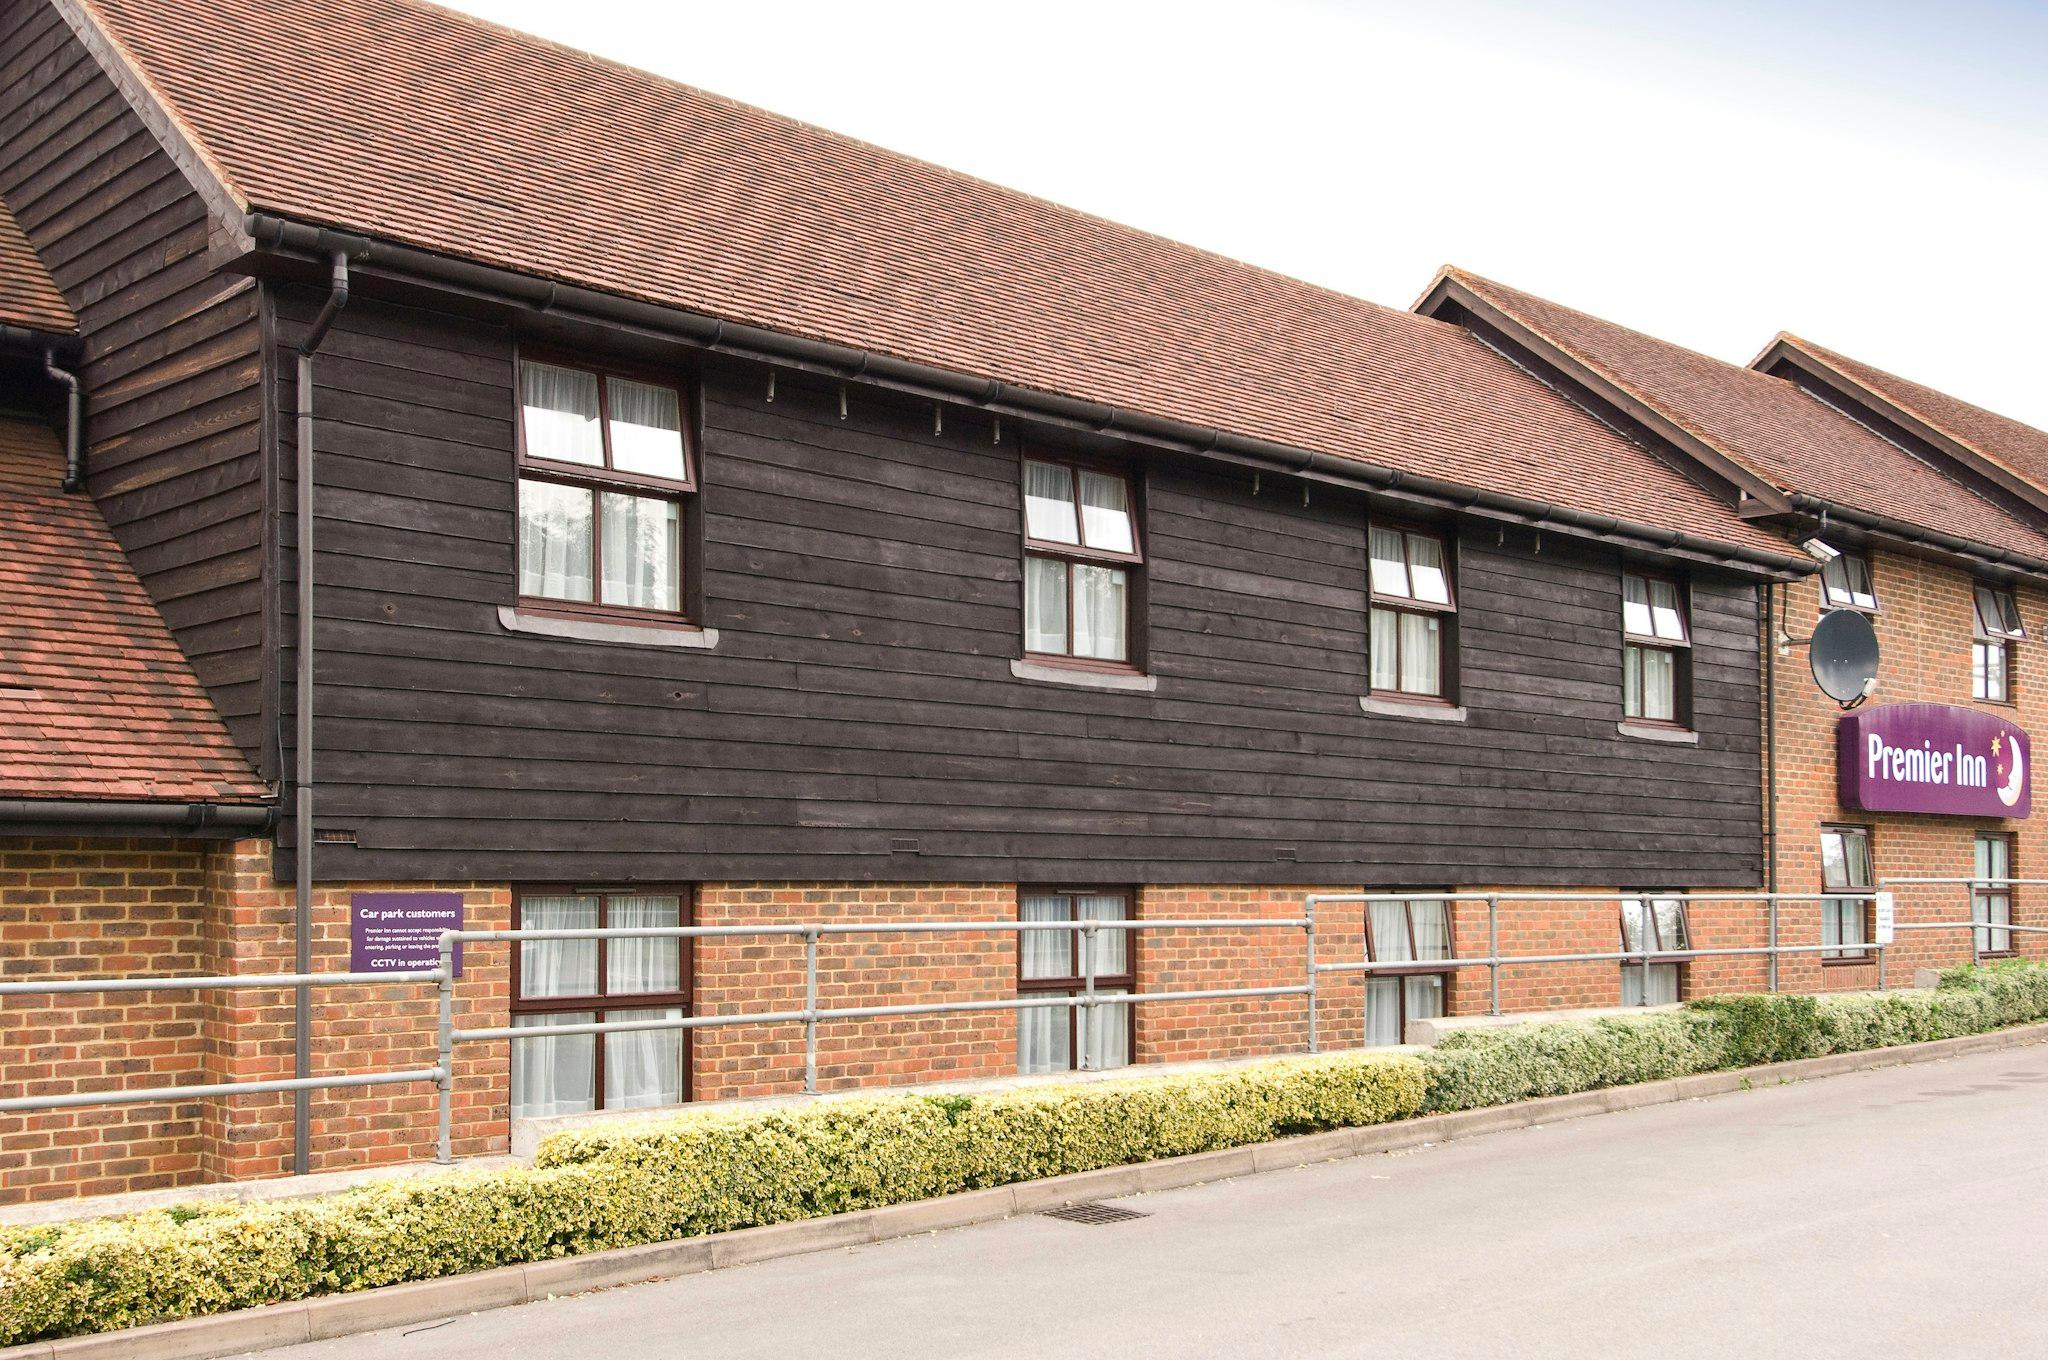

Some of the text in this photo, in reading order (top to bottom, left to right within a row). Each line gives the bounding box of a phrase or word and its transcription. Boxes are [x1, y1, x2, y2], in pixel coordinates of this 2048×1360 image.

[1868, 733, 1987, 788] Premier Inn
[360, 909, 456, 921] Car park customers
[371, 959, 396, 967] CCTV
[398, 958, 405, 967] in
